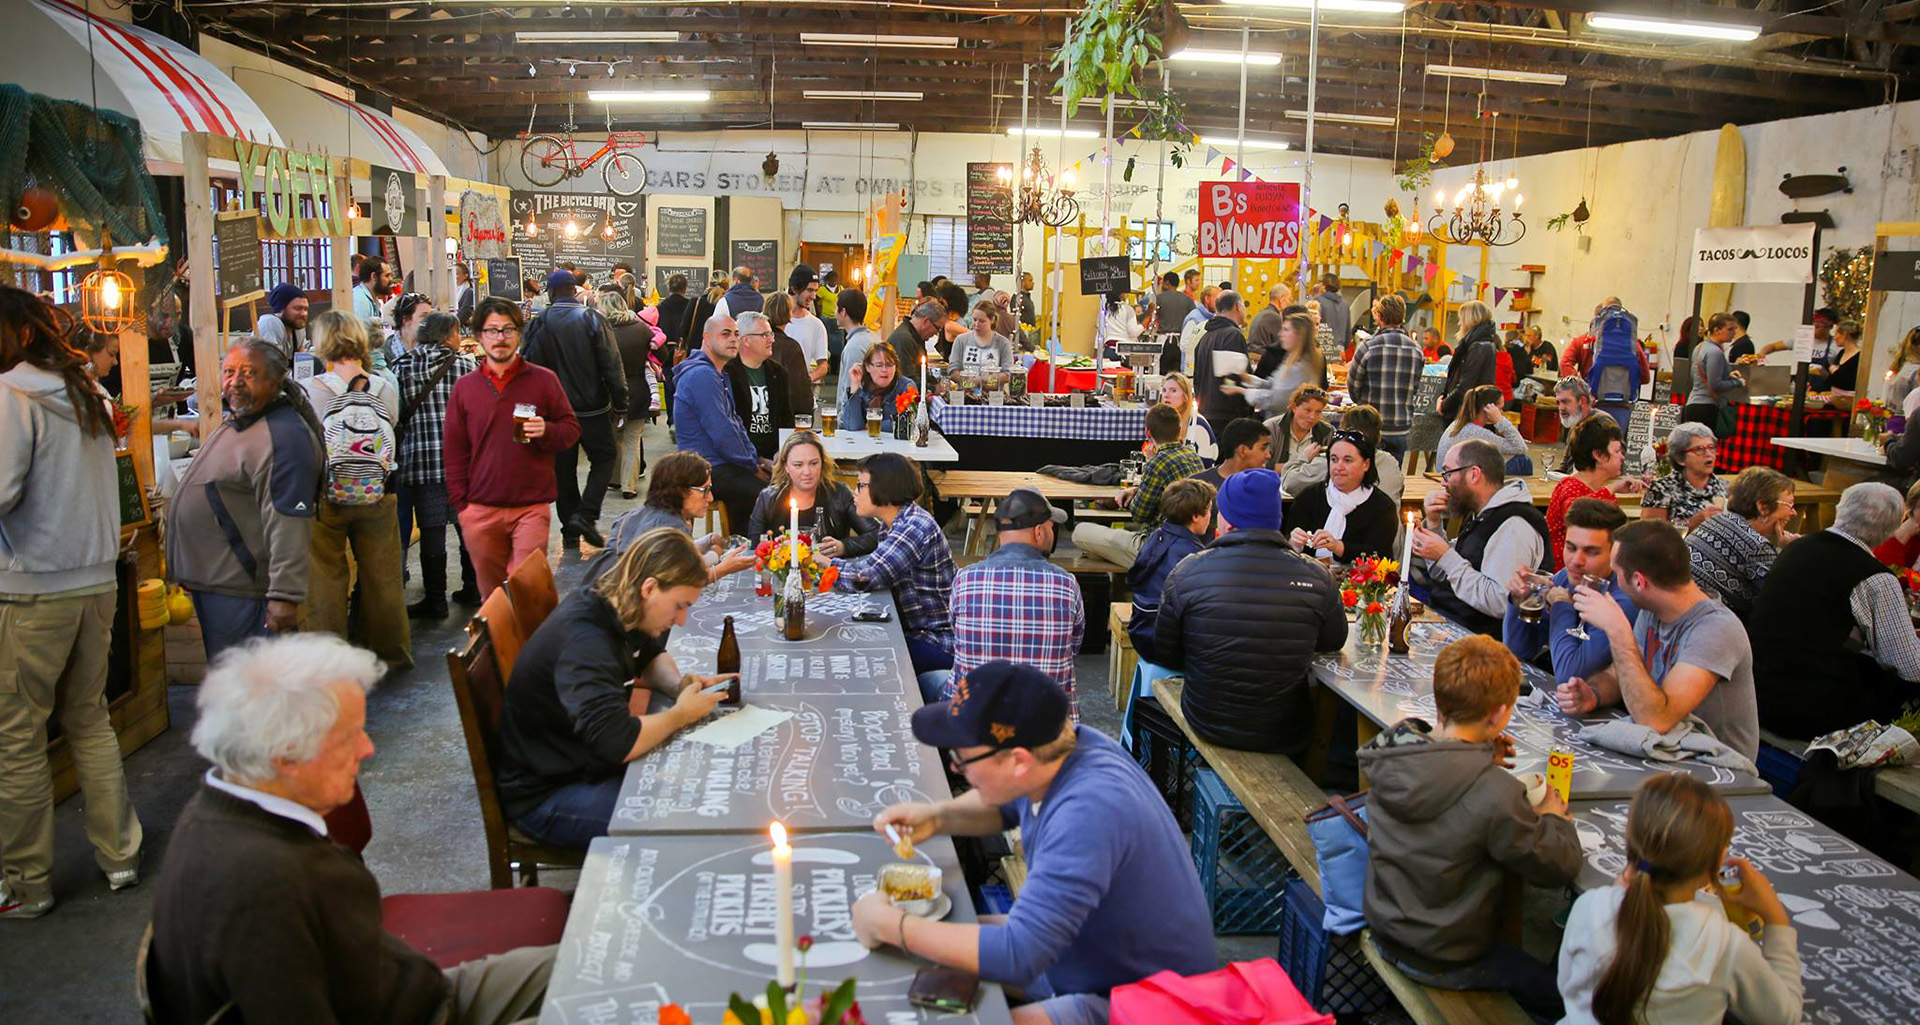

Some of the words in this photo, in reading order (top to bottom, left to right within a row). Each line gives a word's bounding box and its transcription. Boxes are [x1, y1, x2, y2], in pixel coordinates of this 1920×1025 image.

[645, 171, 706, 189] CARS
[816, 176, 845, 194] AT
[534, 194, 560, 215] THE
[560, 195, 592, 207] BICYCLE
[593, 195, 616, 217] BAR
[1211, 184, 1248, 217] B's
[1200, 216, 1299, 257] BUNNIES
[1699, 247, 1736, 262] TACOS
[1766, 245, 1809, 261] LOCOS
[829, 654, 852, 673] WINE
[794, 711, 823, 743] STOP
[856, 711, 892, 742] Bicycle
[757, 745, 781, 774] behind
[869, 743, 902, 771] Blend
[695, 758, 735, 818] DARLING
[709, 874, 747, 937] PICKLES
